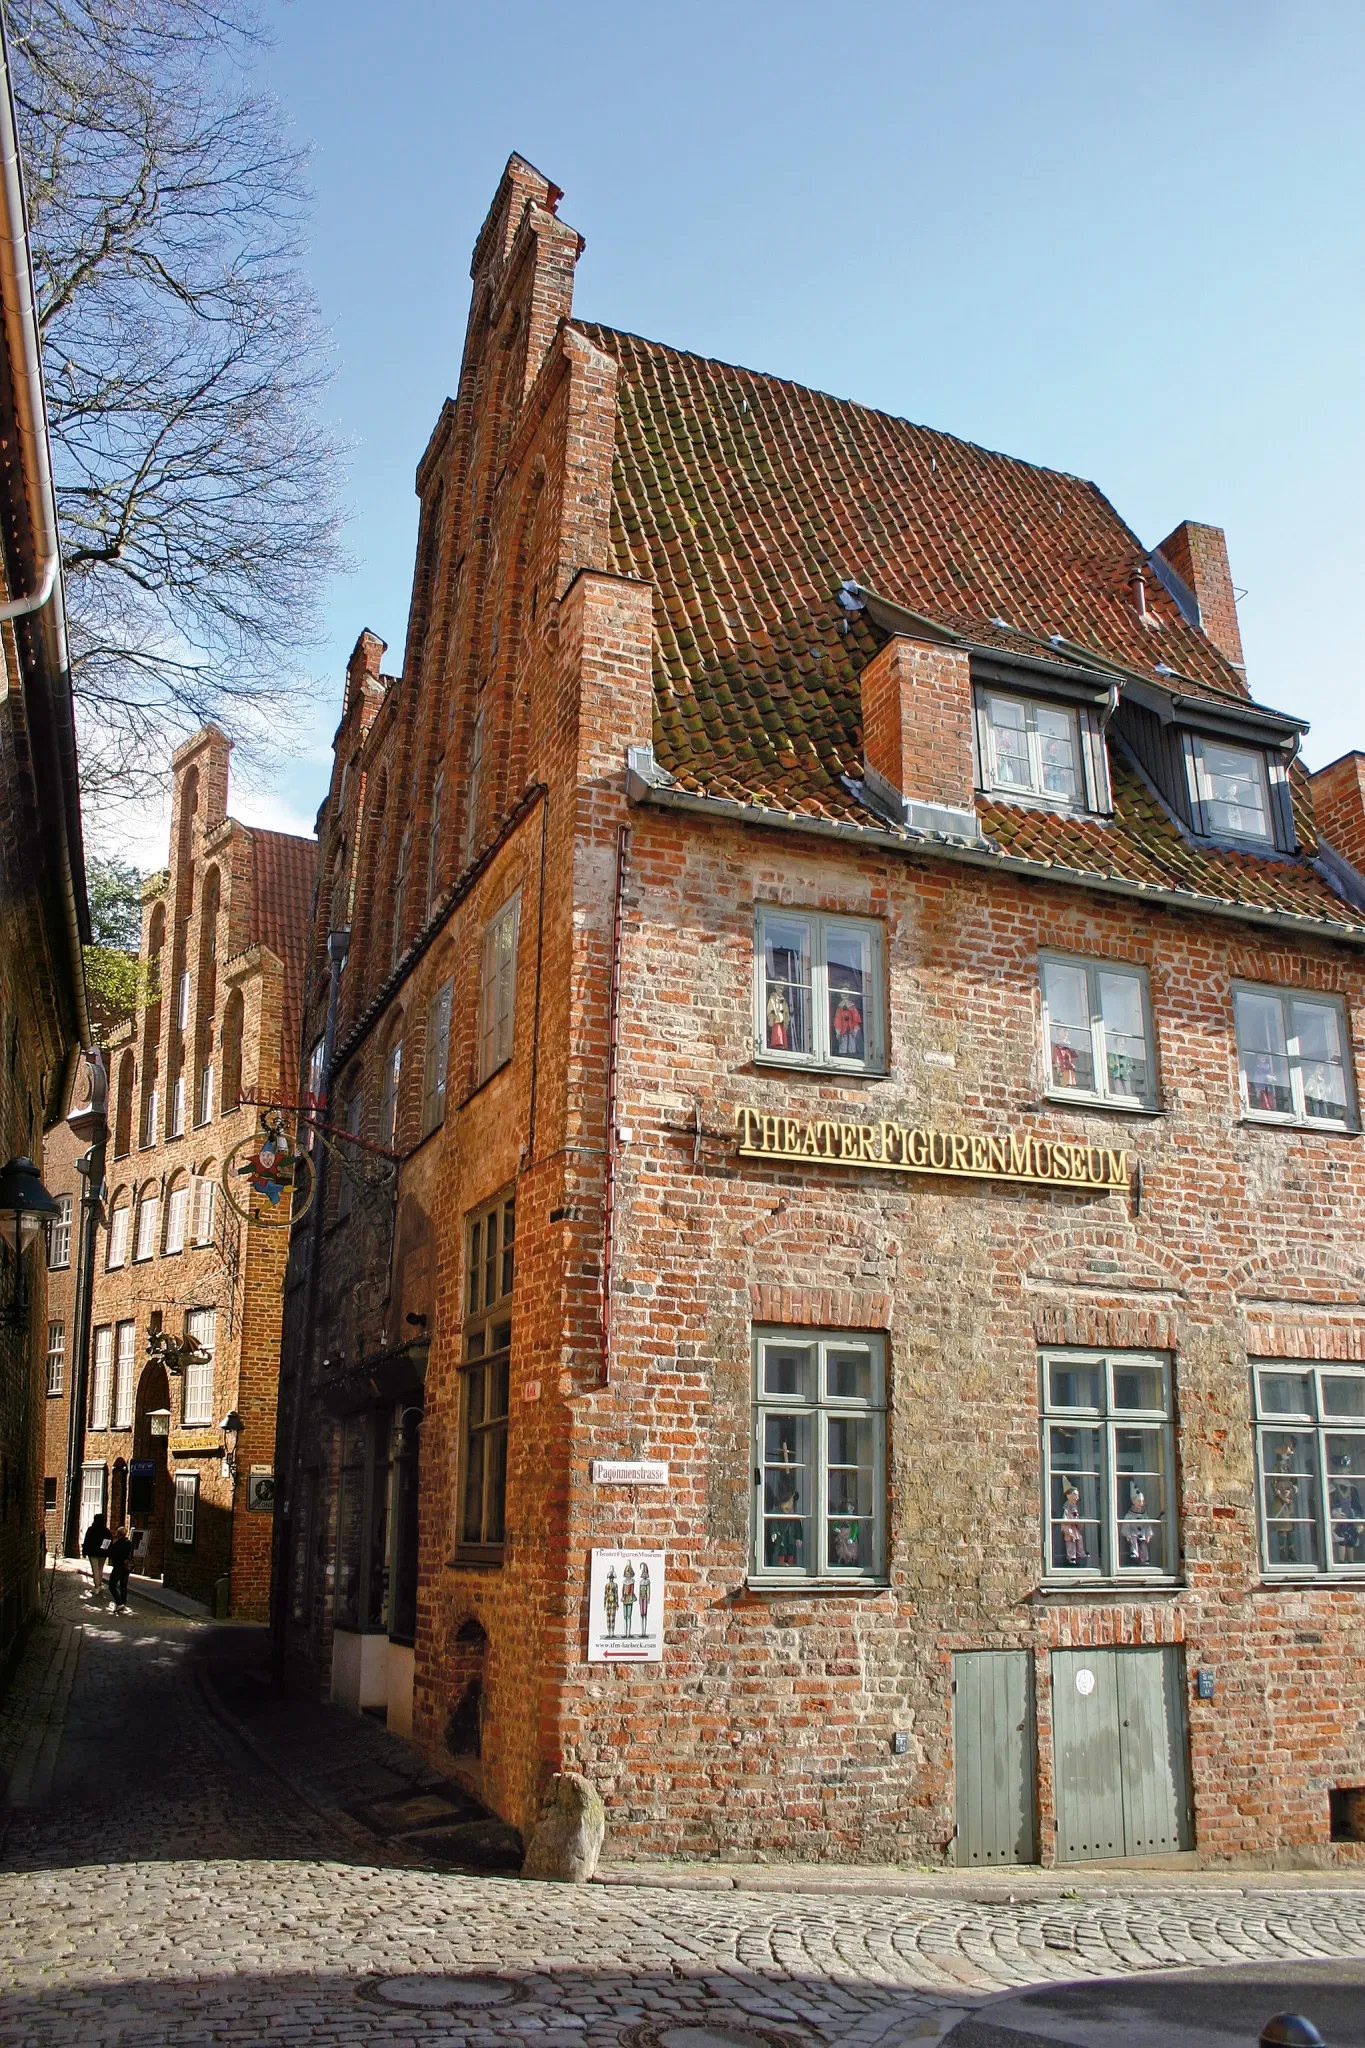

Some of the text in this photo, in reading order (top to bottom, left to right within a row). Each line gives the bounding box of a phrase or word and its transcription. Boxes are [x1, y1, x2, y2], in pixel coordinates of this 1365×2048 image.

[235, 1086, 327, 1109] MUSEUM
[597, 1464, 664, 1482] Pagönnienstrasse
[595, 1550, 662, 1558] TheaterFigurenMuseum
